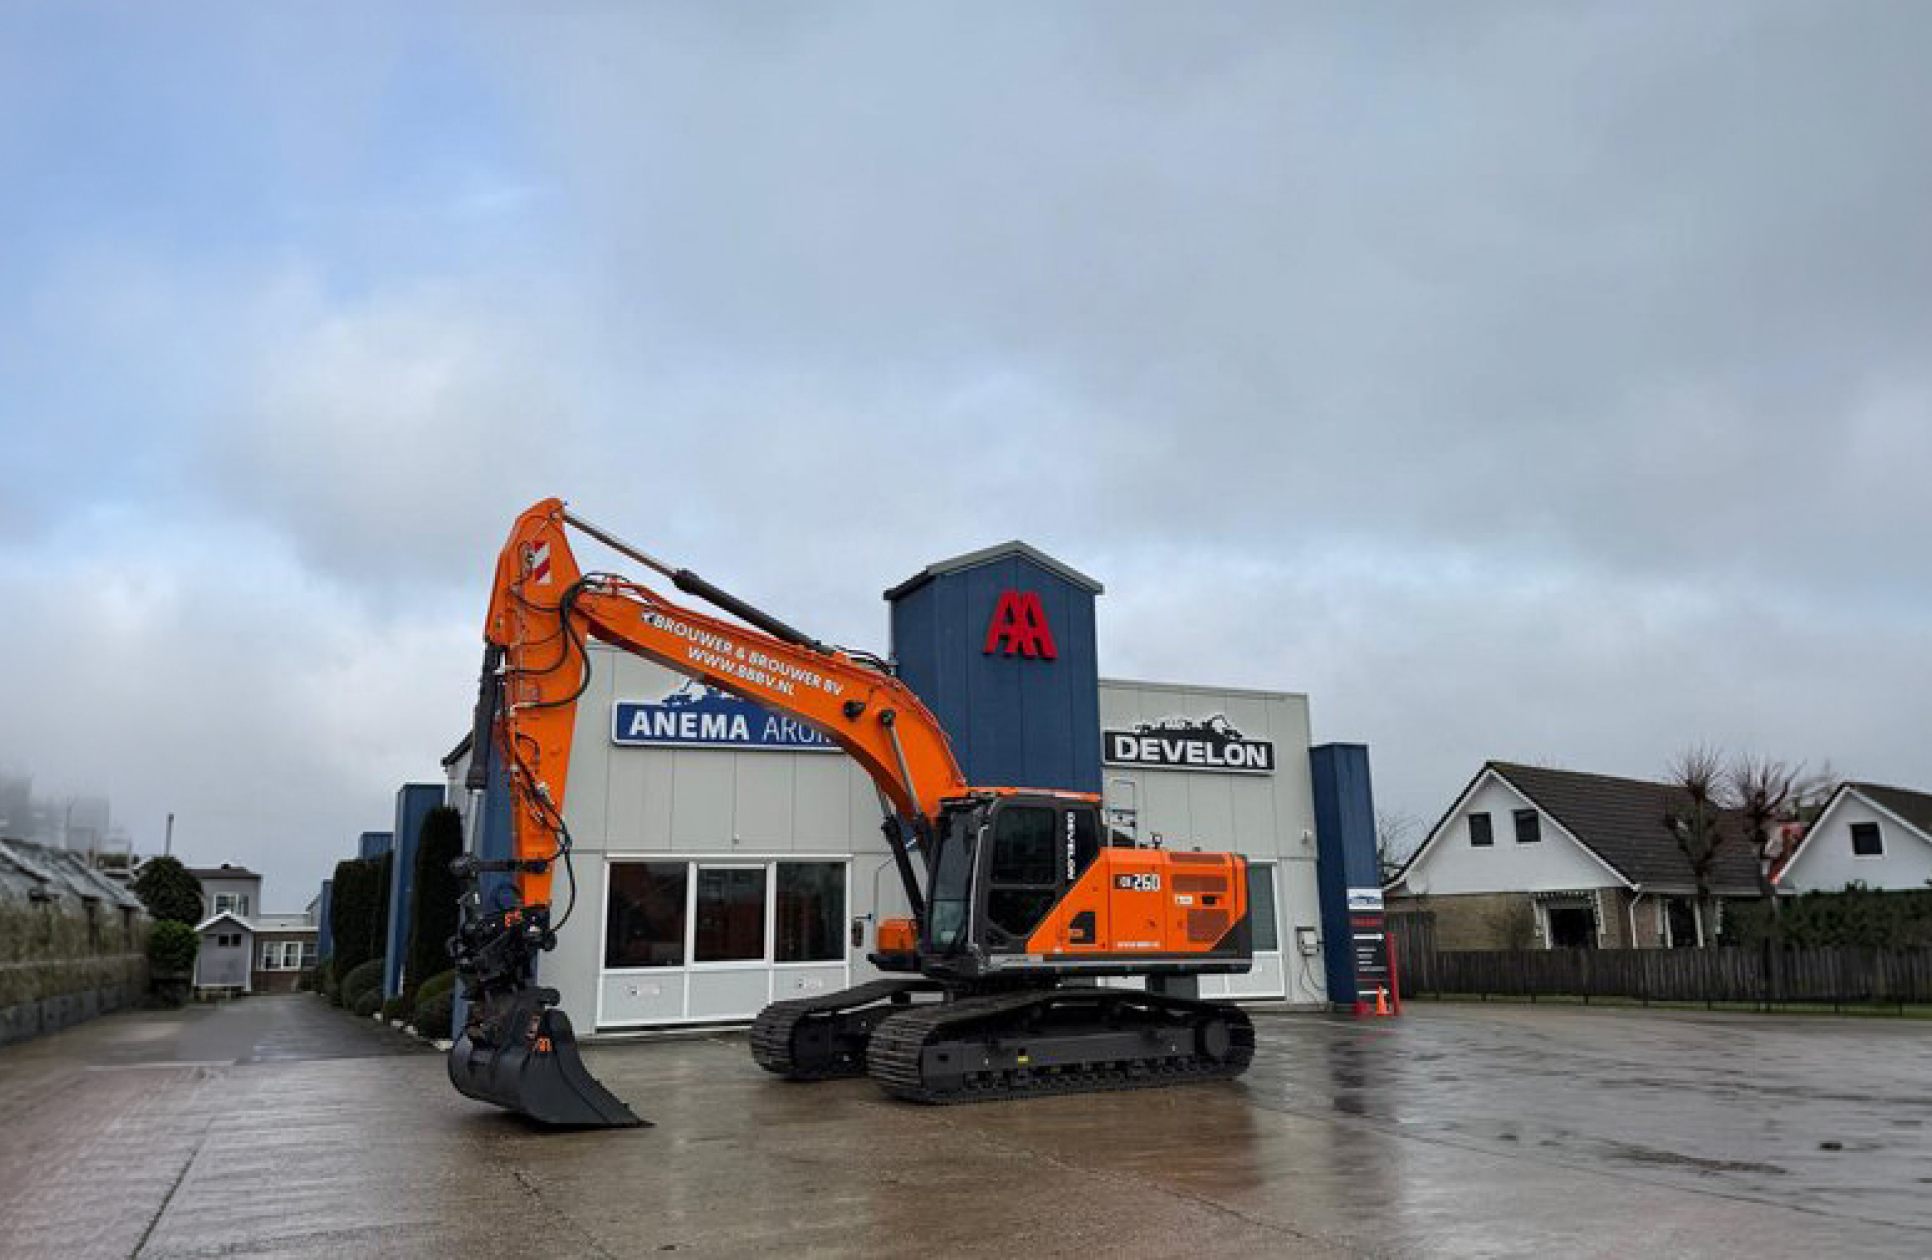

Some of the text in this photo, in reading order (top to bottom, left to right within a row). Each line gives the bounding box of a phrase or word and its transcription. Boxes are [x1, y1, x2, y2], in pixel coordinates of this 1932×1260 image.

[654, 614, 733, 652] BROUWER
[749, 651, 822, 689] BROUWER
[629, 711, 750, 741] ANEMA
[1114, 735, 1268, 768] DEVELON
